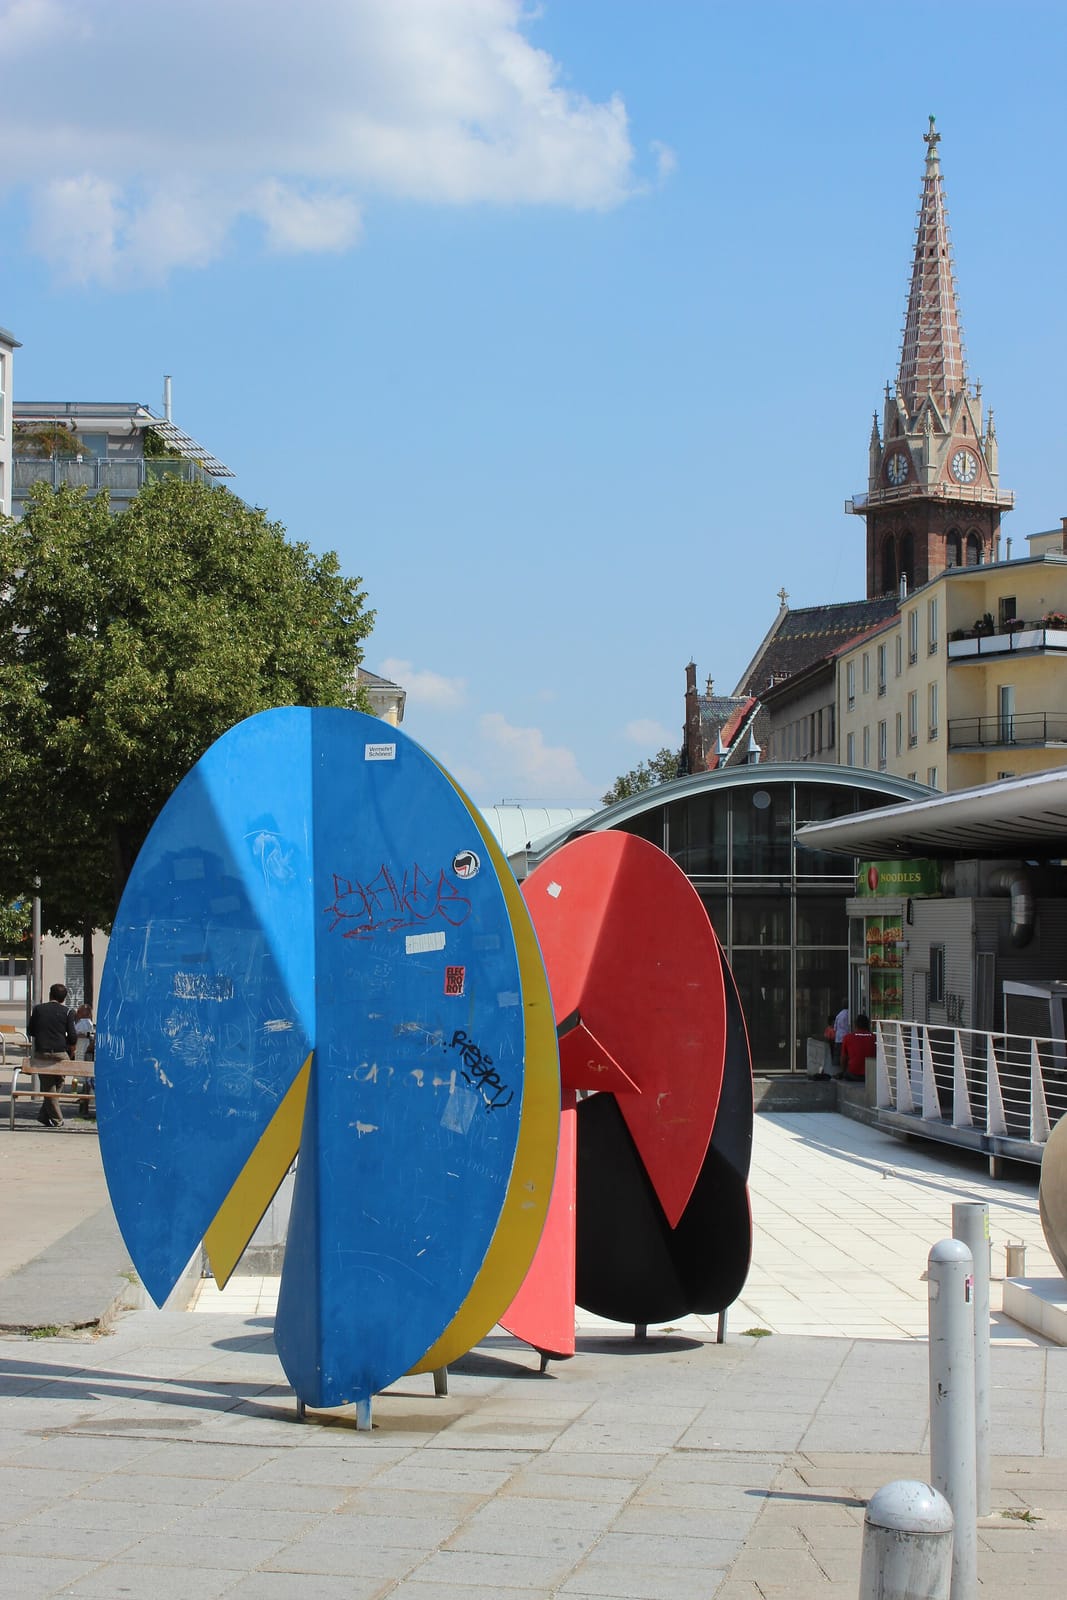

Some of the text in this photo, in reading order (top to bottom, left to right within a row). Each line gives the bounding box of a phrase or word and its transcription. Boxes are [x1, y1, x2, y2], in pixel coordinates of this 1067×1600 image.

[880, 872, 921, 883] NOODLES
[447, 967, 464, 976] ELEC
[447, 976, 463, 984] TRO
